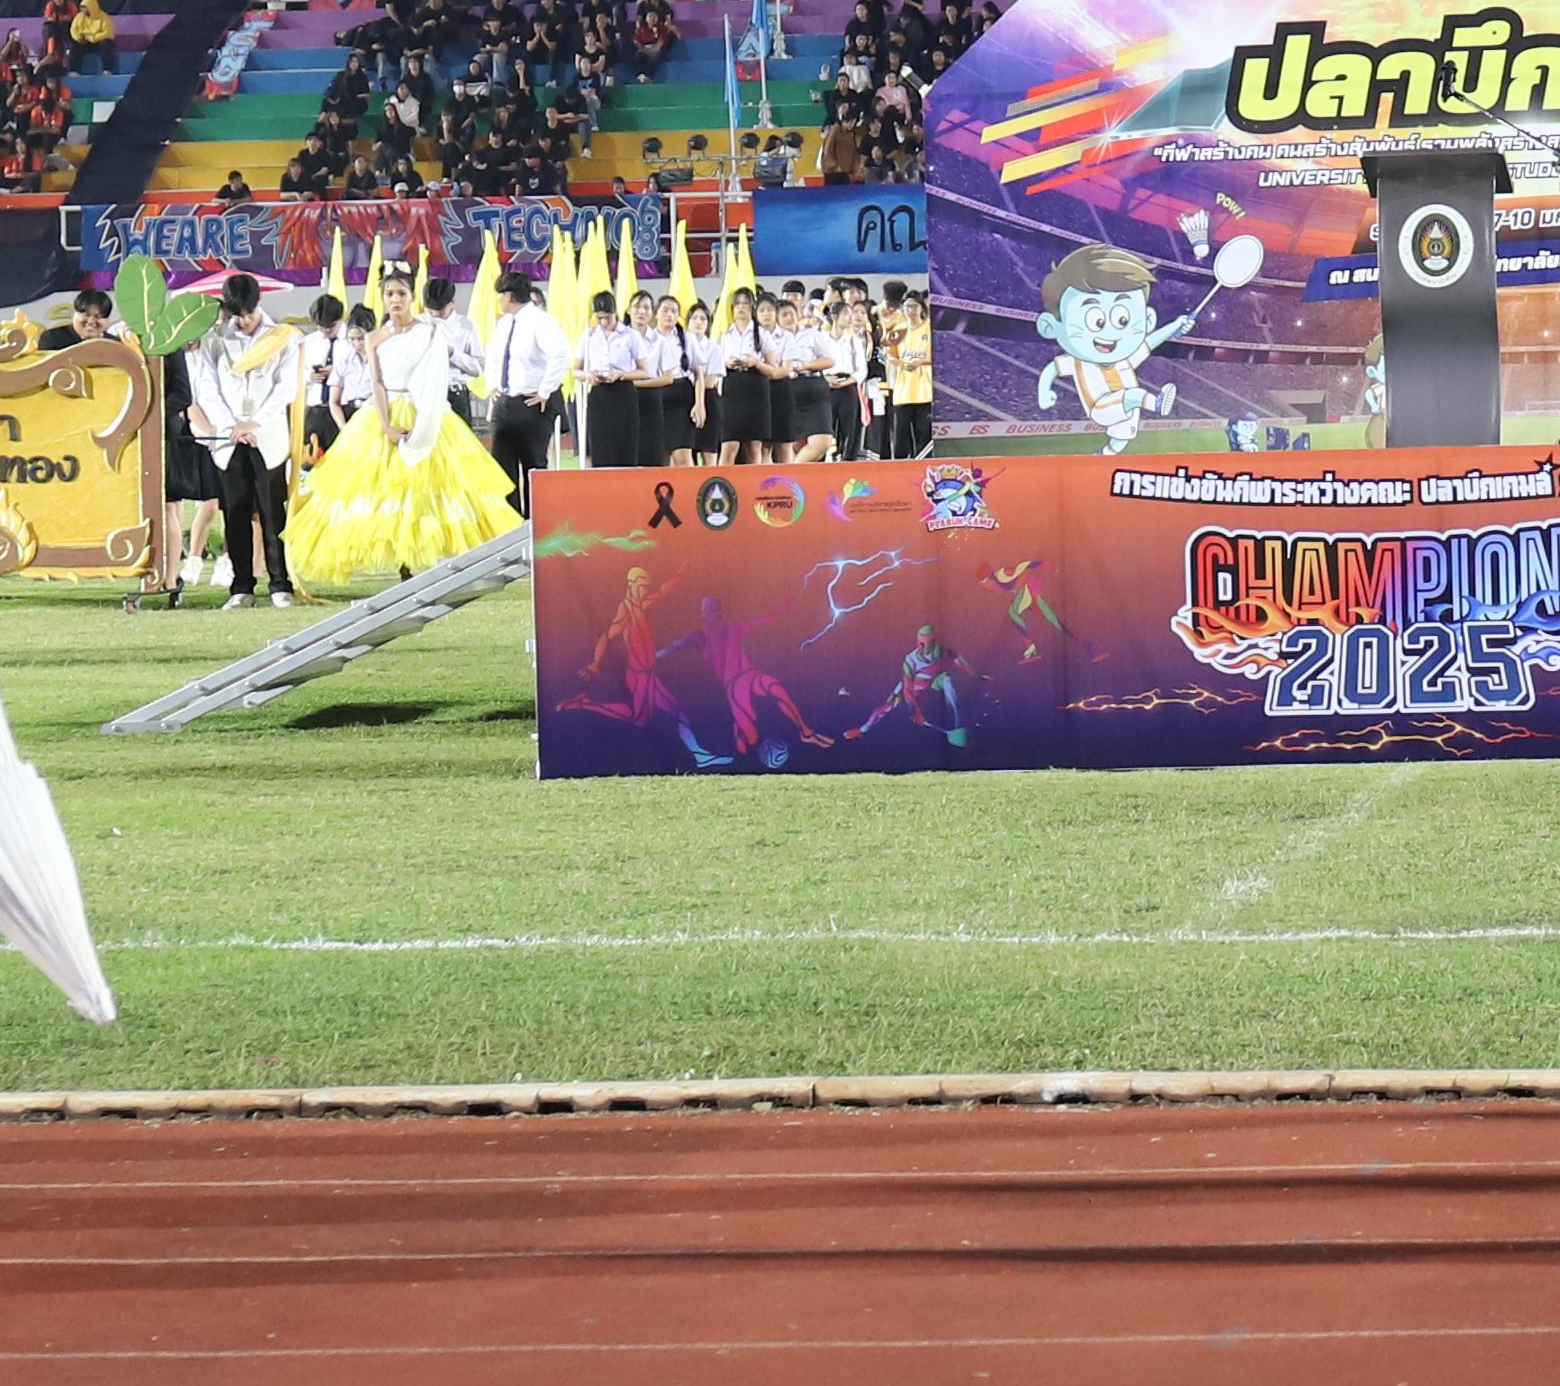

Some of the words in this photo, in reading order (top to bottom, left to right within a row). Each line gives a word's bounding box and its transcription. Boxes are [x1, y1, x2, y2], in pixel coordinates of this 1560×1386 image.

[1258, 168, 1367, 188] UNIVERSIT
[1004, 422, 1074, 435] BUSINESS
[1271, 624, 1528, 711] 2025
